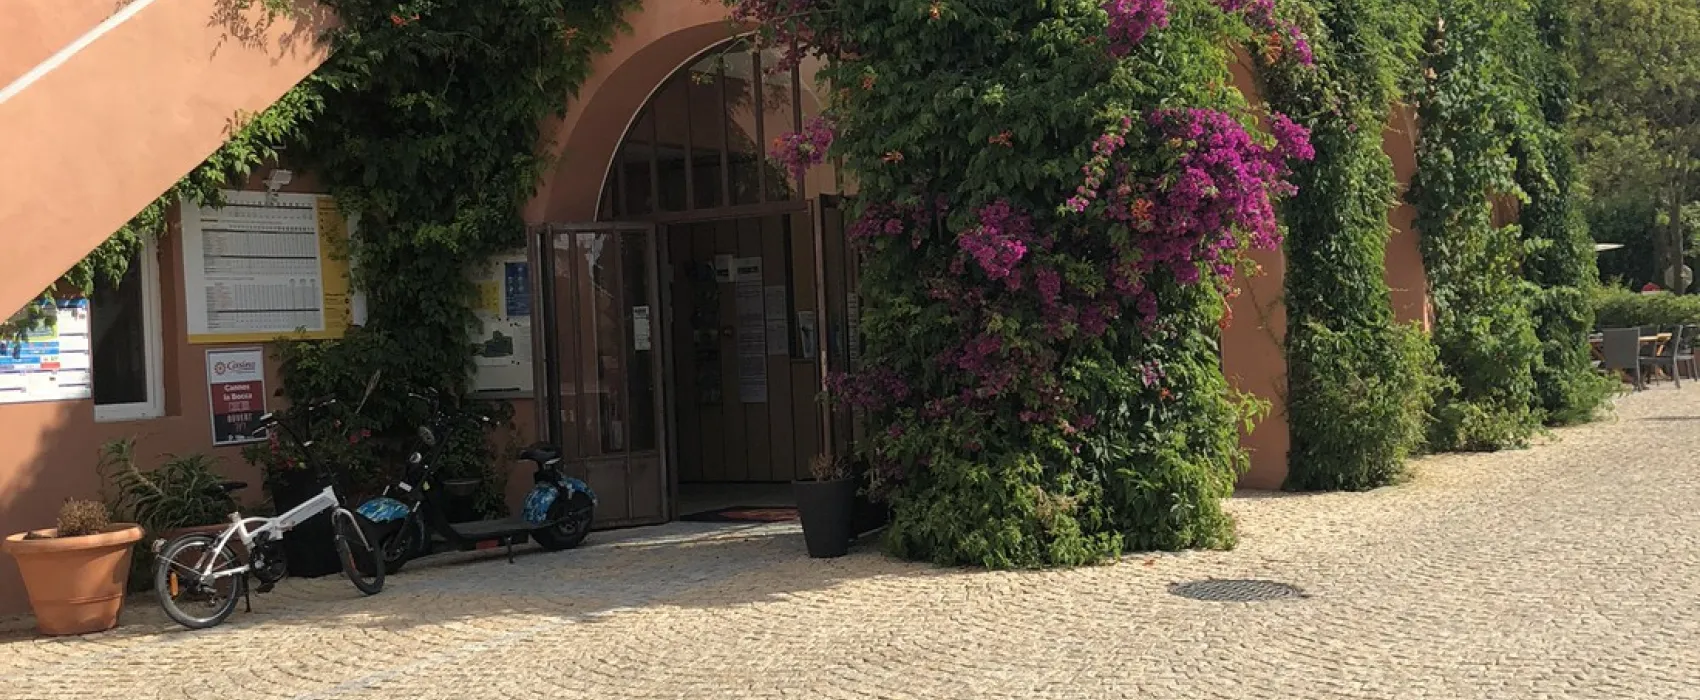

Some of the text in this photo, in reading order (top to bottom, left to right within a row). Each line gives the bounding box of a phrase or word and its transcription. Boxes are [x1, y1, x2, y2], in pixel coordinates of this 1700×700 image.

[223, 384, 250, 392] Cannes
[223, 392, 253, 401] la Bocca
